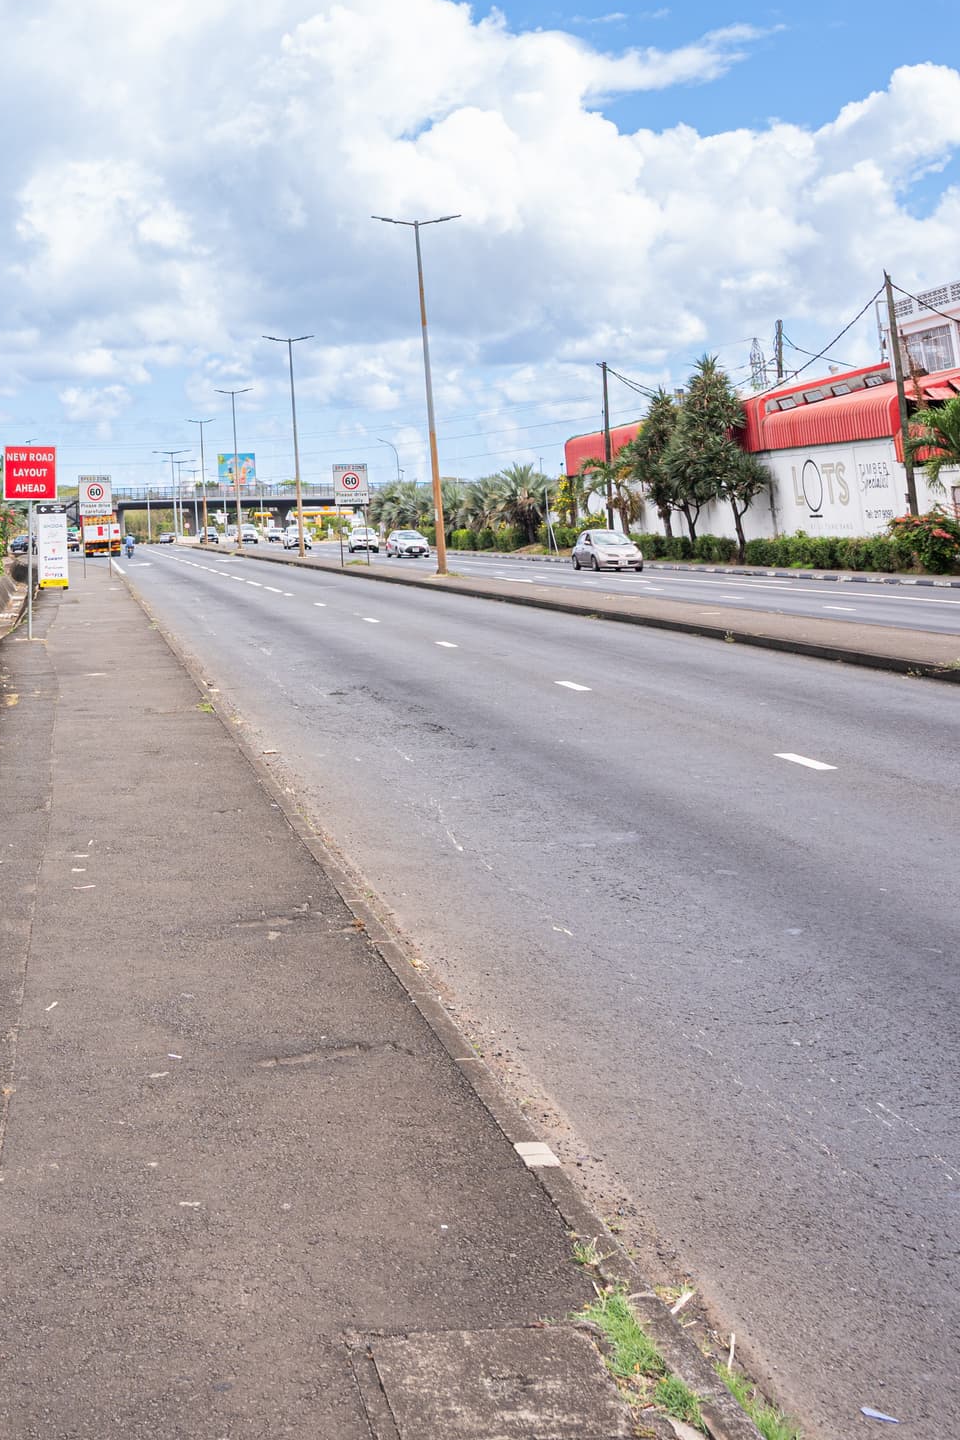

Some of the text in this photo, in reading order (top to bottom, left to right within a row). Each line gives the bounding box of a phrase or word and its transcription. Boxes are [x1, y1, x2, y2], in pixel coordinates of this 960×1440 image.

[6, 453, 54, 462] NEW ROAD
[13, 468, 48, 477] LAYOUT
[345, 477, 356, 485] 60
[15, 483, 46, 493] AHEAD
[791, 459, 850, 513] LOTS
[89, 488, 101, 496] 60
